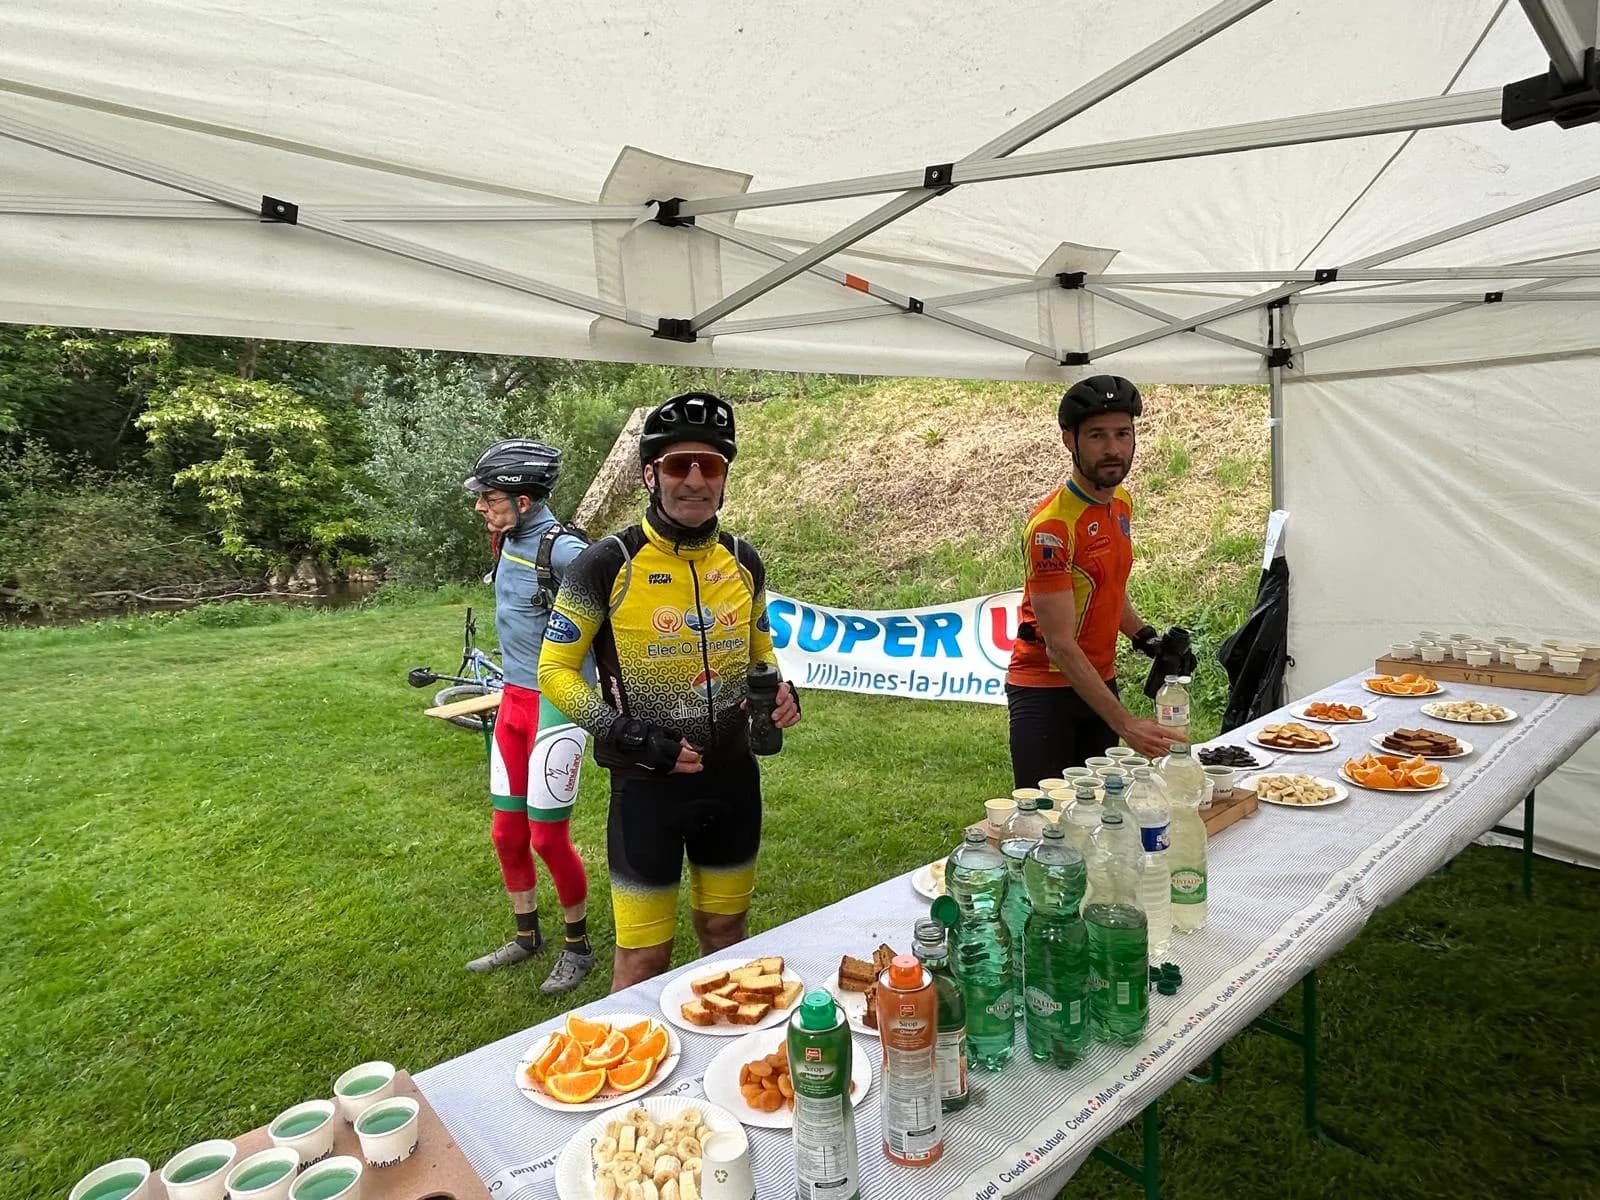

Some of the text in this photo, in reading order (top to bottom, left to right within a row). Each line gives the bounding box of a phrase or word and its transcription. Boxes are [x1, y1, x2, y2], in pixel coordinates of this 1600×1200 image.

[767, 600, 963, 657] SUPER
[807, 663, 1008, 697] Villaines-la-Juhe
[1464, 672, 1495, 684] VTT
[1149, 1037, 1177, 1062] Mutuel
[1065, 1080, 1127, 1131] Crédit Mutuel
[509, 1158, 555, 1179] Mutuel
[999, 1129, 1068, 1184] Crédit Mutuel
[975, 1181, 1000, 1200] tuel
